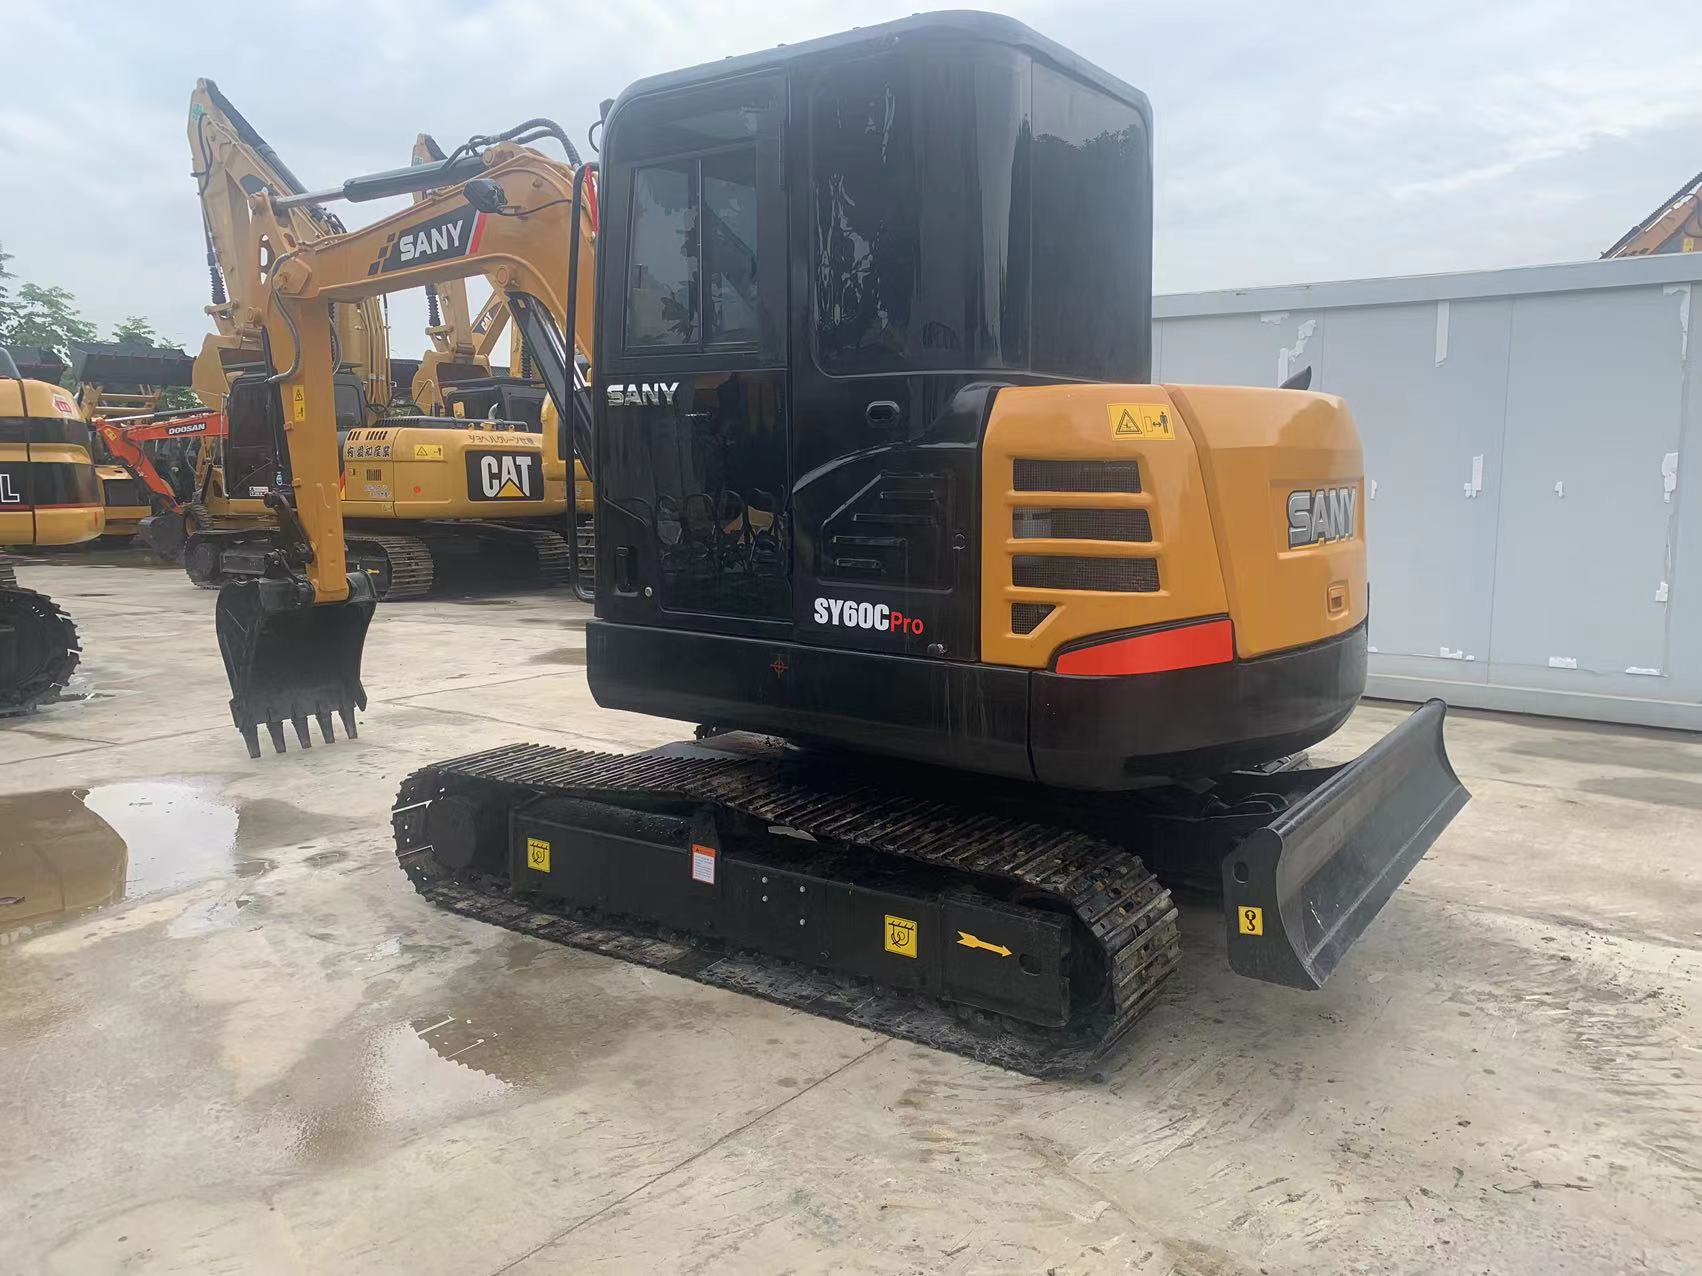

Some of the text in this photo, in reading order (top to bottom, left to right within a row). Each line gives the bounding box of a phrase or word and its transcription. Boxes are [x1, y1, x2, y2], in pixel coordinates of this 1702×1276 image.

[399, 220, 463, 261] SANY
[606, 382, 680, 406] SANY
[168, 423, 206, 435] DOOSAN
[480, 455, 532, 498] CAT
[1286, 487, 1356, 549] SANY
